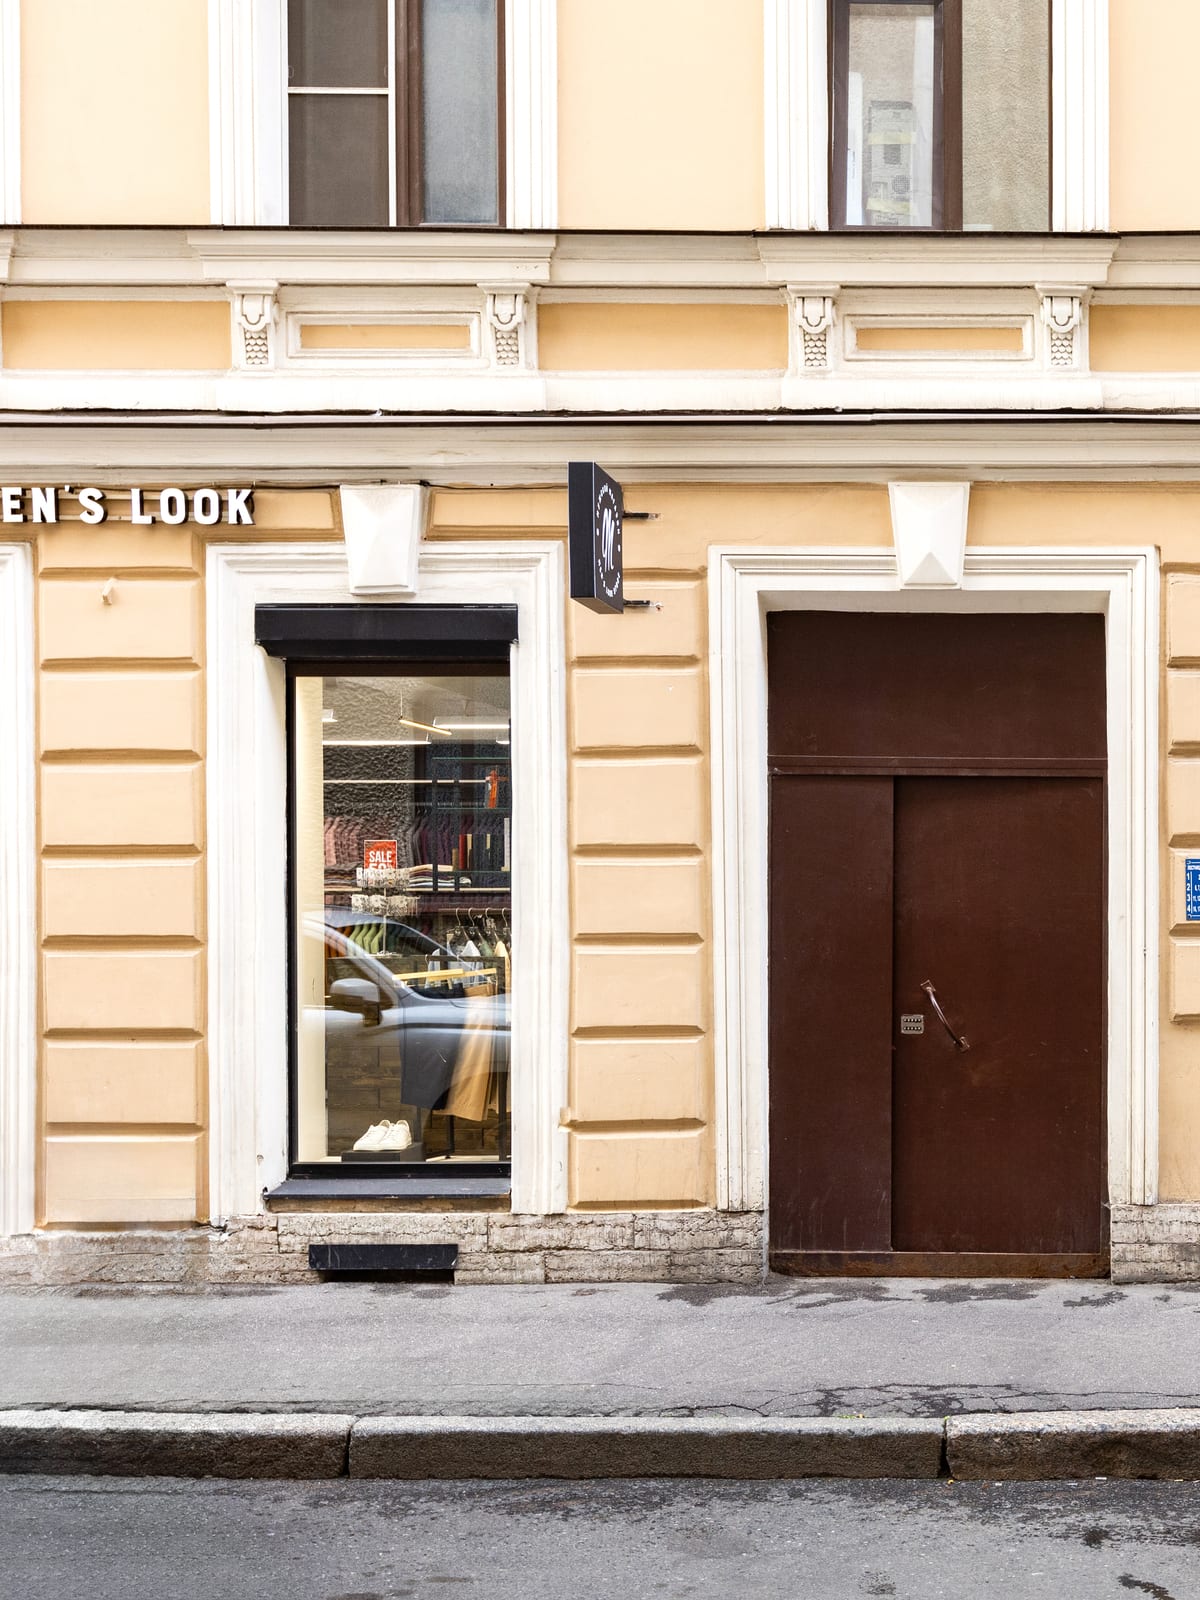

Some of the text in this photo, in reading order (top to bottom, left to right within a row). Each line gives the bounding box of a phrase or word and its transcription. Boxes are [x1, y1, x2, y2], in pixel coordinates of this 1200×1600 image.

[1, 485, 254, 525] EN'S LOOK
[369, 850, 393, 863] SALE
[1186, 883, 1191, 891] 2
[1186, 894, 1191, 902] 3
